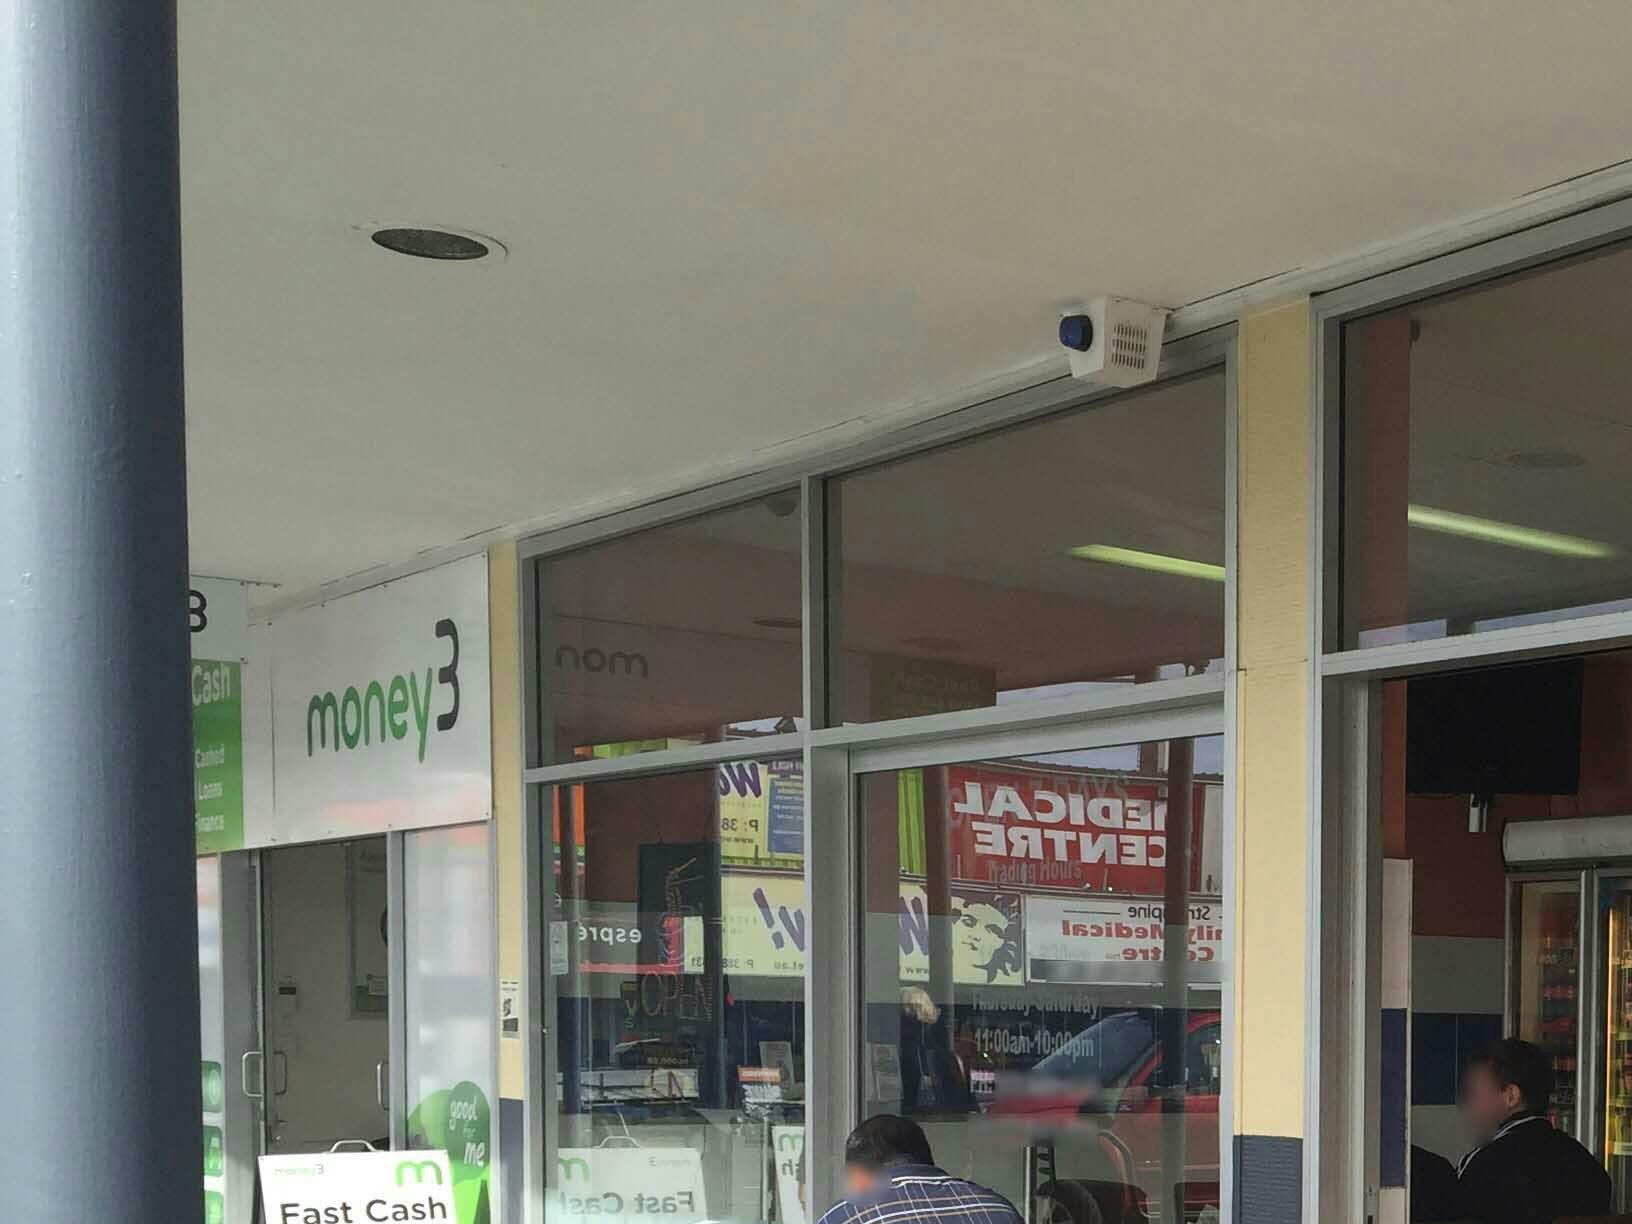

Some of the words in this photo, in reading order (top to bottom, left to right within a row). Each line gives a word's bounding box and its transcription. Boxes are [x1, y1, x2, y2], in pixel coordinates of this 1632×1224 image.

[1040, 857, 1082, 881] Hours
[450, 1097, 477, 1130] good
[464, 1141, 486, 1168] me
[366, 1196, 447, 1222] Cash
